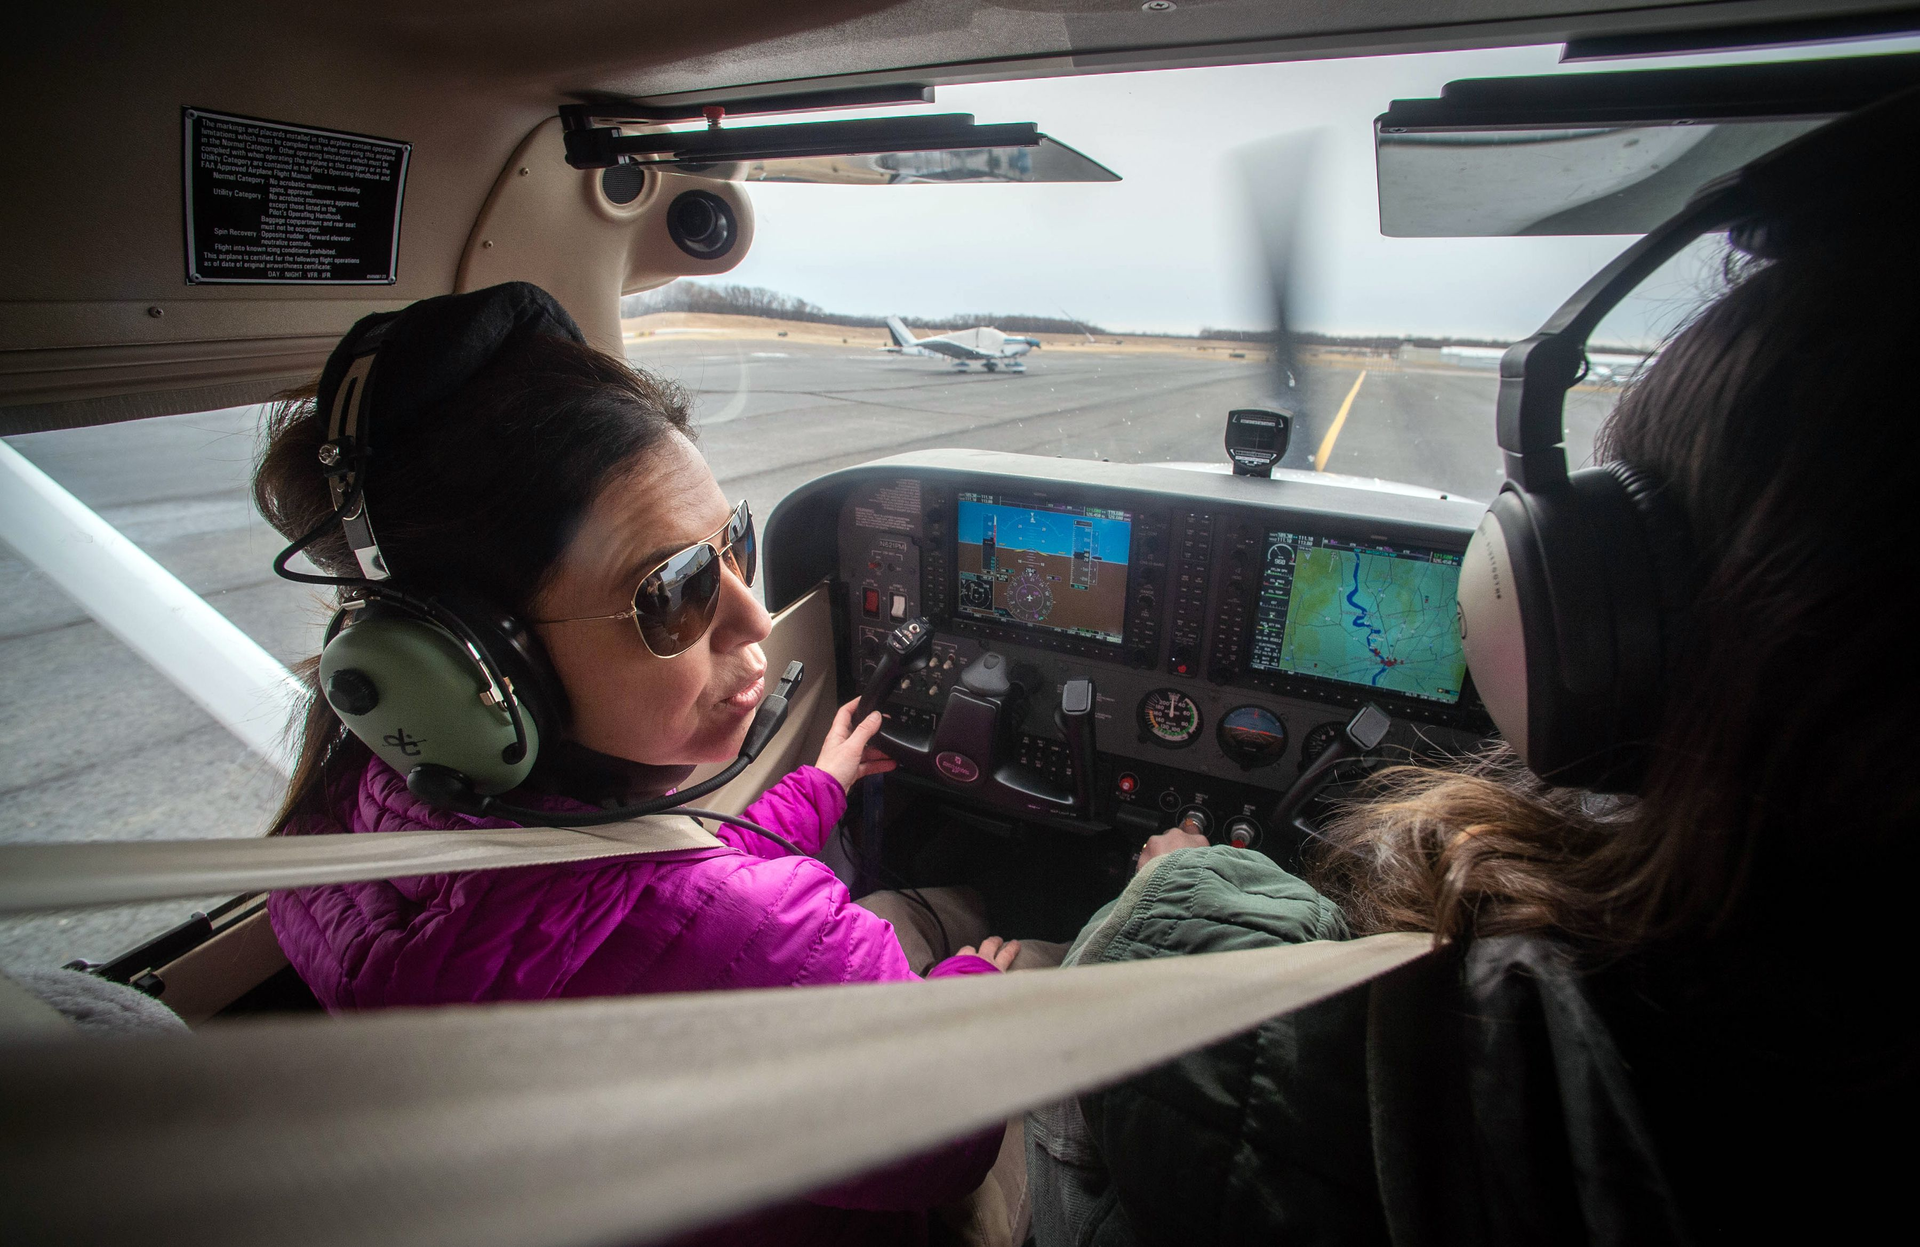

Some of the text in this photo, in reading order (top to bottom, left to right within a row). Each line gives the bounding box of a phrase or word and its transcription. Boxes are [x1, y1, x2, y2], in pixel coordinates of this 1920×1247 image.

[201, 127, 235, 138] limitations
[237, 132, 256, 141] which
[282, 139, 308, 149] complied
[338, 147, 364, 157] operating
[375, 153, 395, 162] airplane
[216, 121, 245, 132] markings
[260, 128, 285, 138] placards
[286, 132, 310, 141] installed
[329, 138, 350, 148] airplane
[351, 142, 371, 150] contain
[371, 145, 396, 155] operating
[200, 144, 230, 155] complied
[265, 153, 293, 163] operating
[305, 158, 327, 167] airplane
[345, 163, 368, 172] category
[221, 138, 244, 147] Normal
[296, 149, 322, 159] operating
[323, 153, 351, 162] limitations
[200, 152, 221, 162] Utility
[222, 155, 251, 165] Category
[263, 160, 292, 169] contained
[328, 168, 354, 178] Operating
[216, 162, 246, 173] Approved
[247, 166, 272, 176] Airplane
[273, 169, 289, 178] Flight
[237, 174, 264, 184] Category
[213, 188, 232, 196] Utility
[234, 190, 261, 199] Category
[286, 218, 322, 226] compartment
[287, 210, 314, 218] Operating
